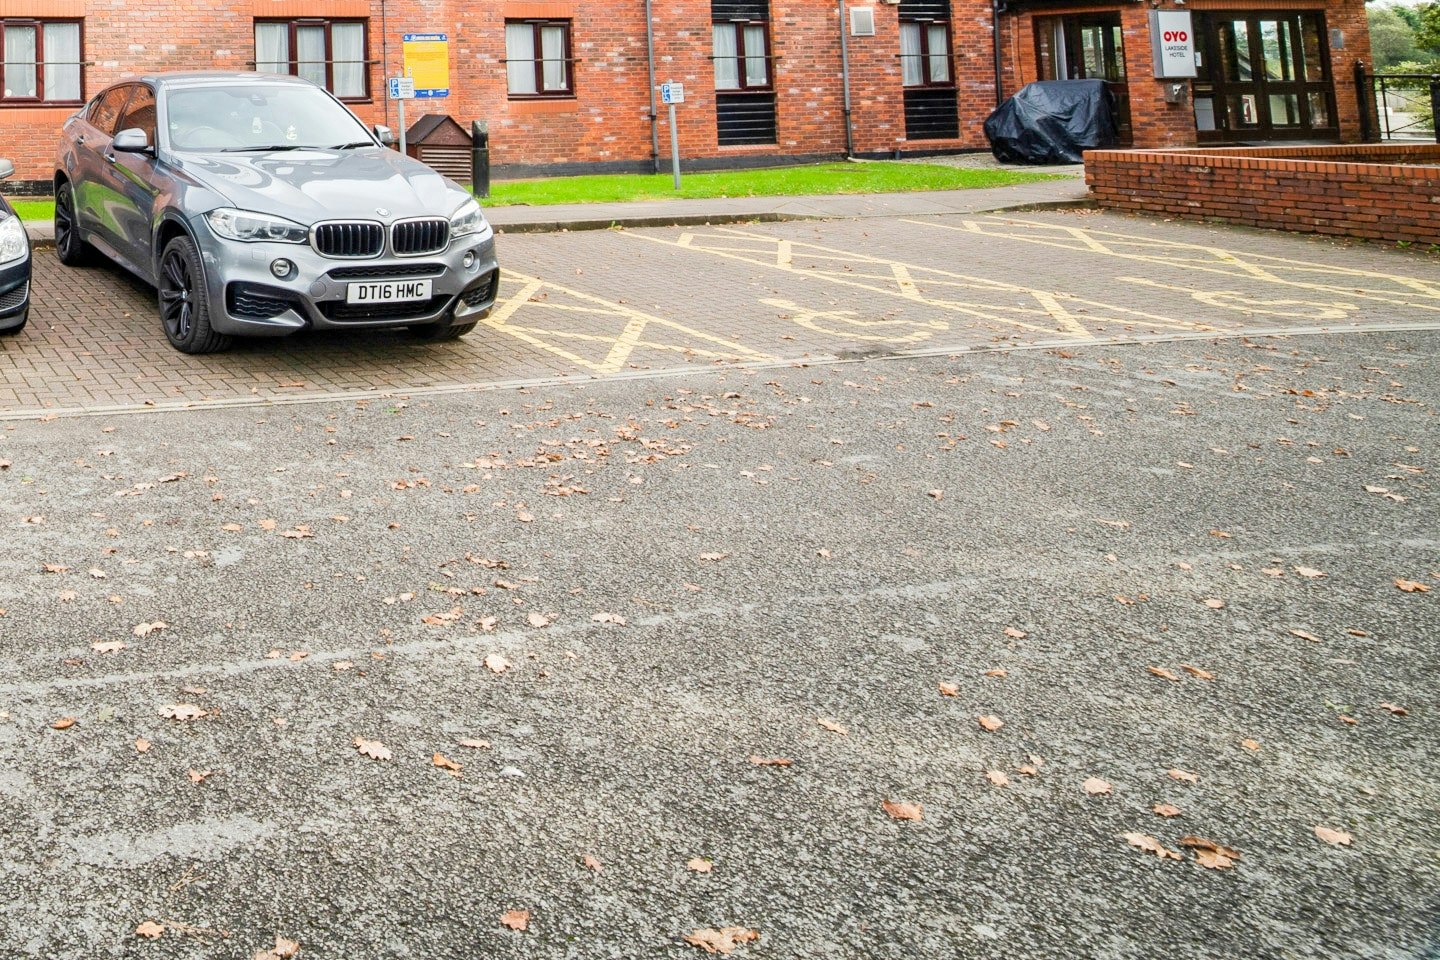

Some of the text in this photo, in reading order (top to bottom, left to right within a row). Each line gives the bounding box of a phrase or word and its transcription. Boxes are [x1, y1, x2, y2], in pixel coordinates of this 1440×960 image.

[1163, 30, 1188, 42] OYO
[358, 282, 424, 300] DT16 HMC
